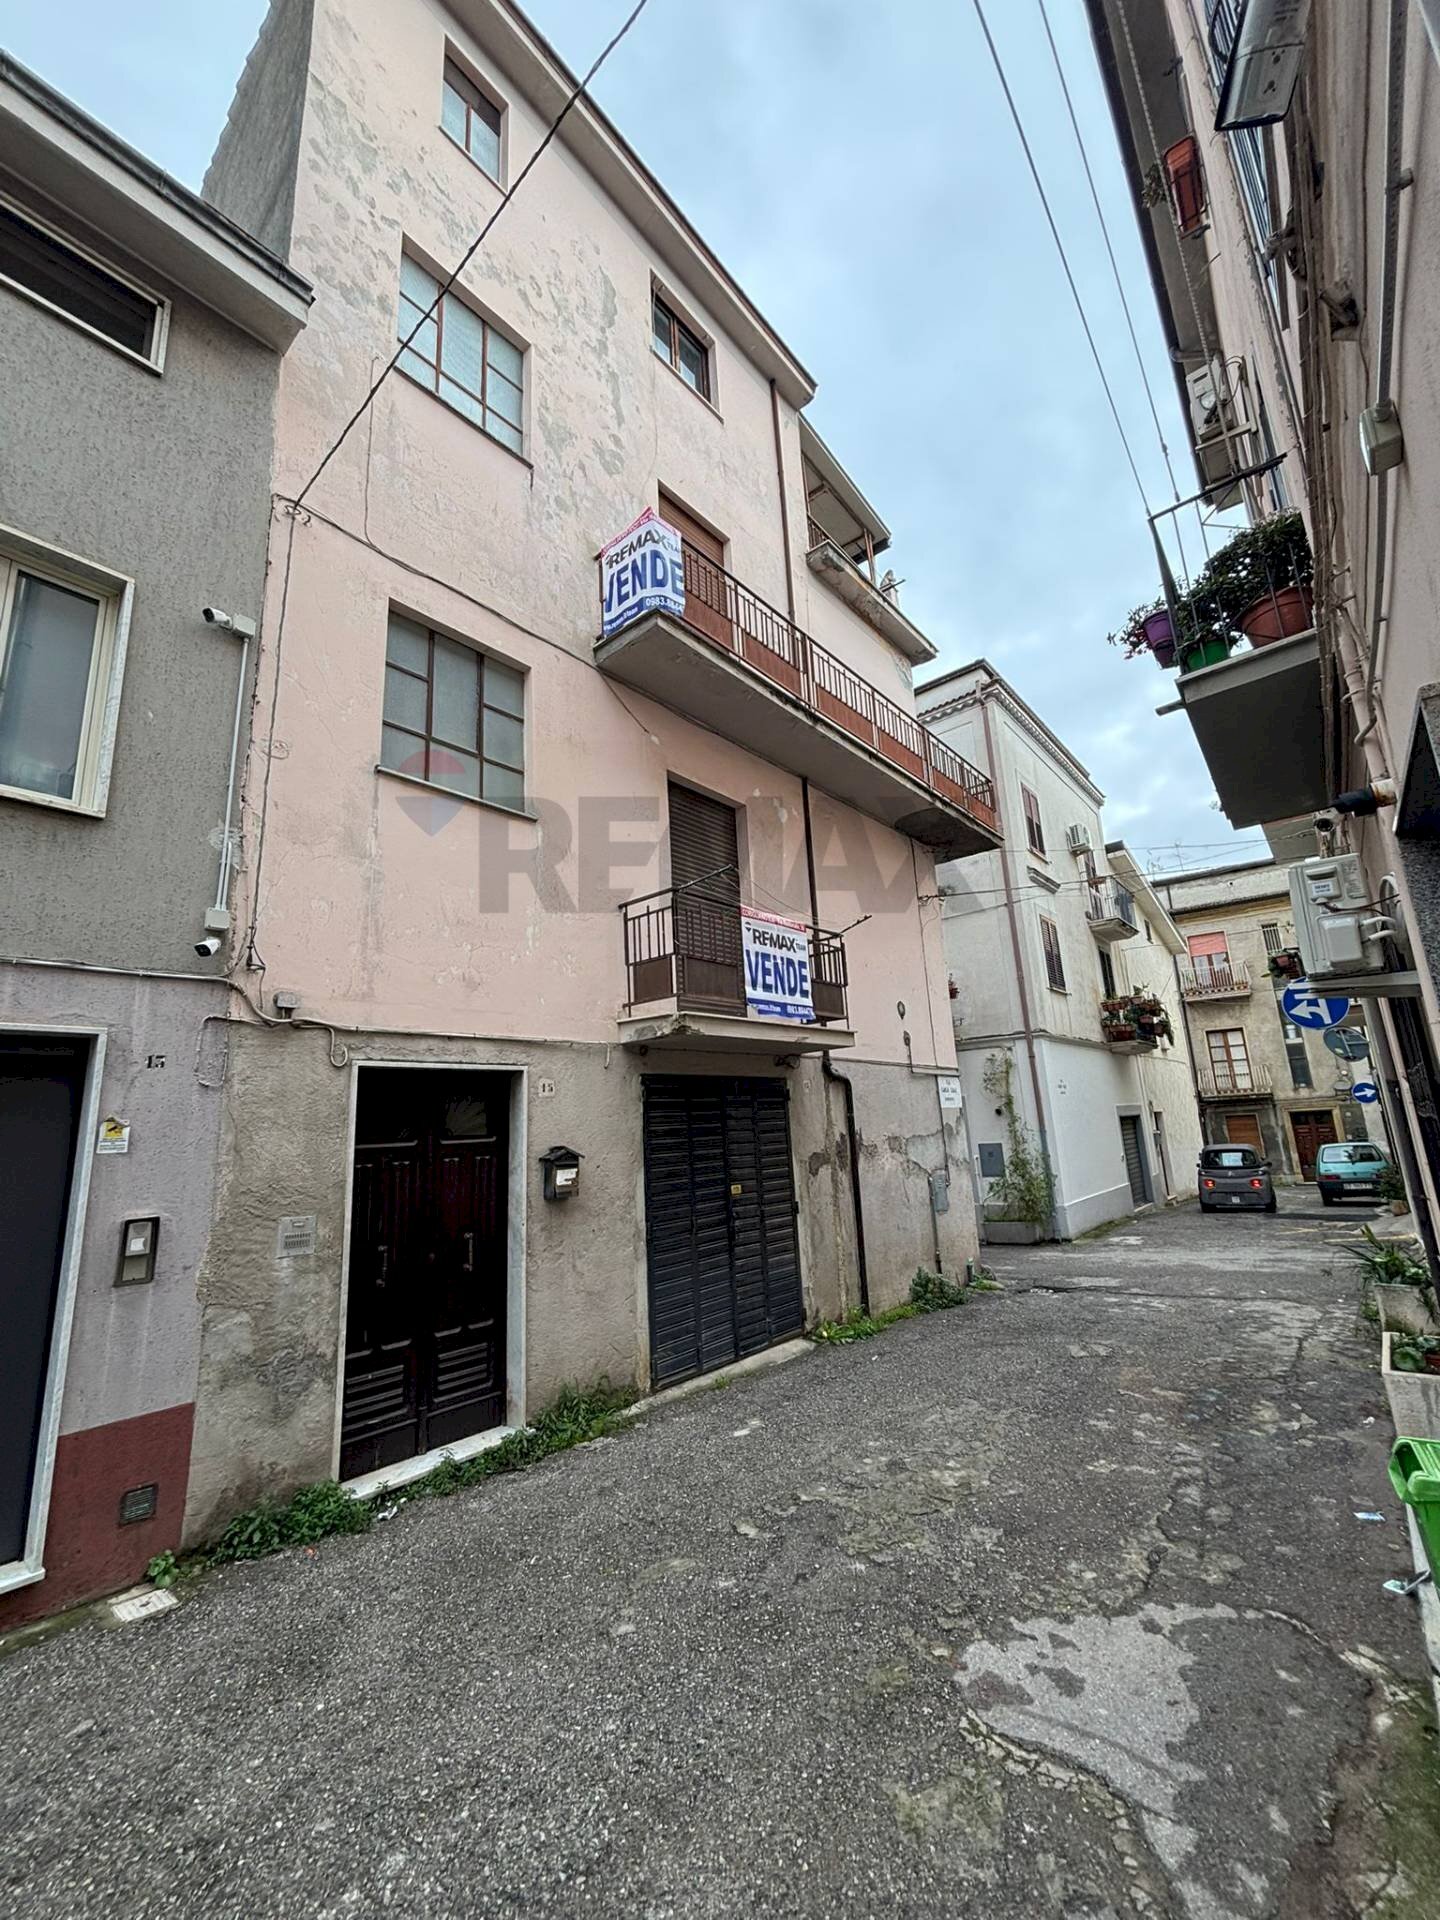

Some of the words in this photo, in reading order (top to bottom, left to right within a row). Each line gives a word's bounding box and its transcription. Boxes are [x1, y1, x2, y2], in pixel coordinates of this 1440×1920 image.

[608, 529, 668, 569] REMAX
[604, 549, 685, 613] VENDE
[752, 928, 796, 953] REMAX
[745, 949, 809, 999] VENDE
